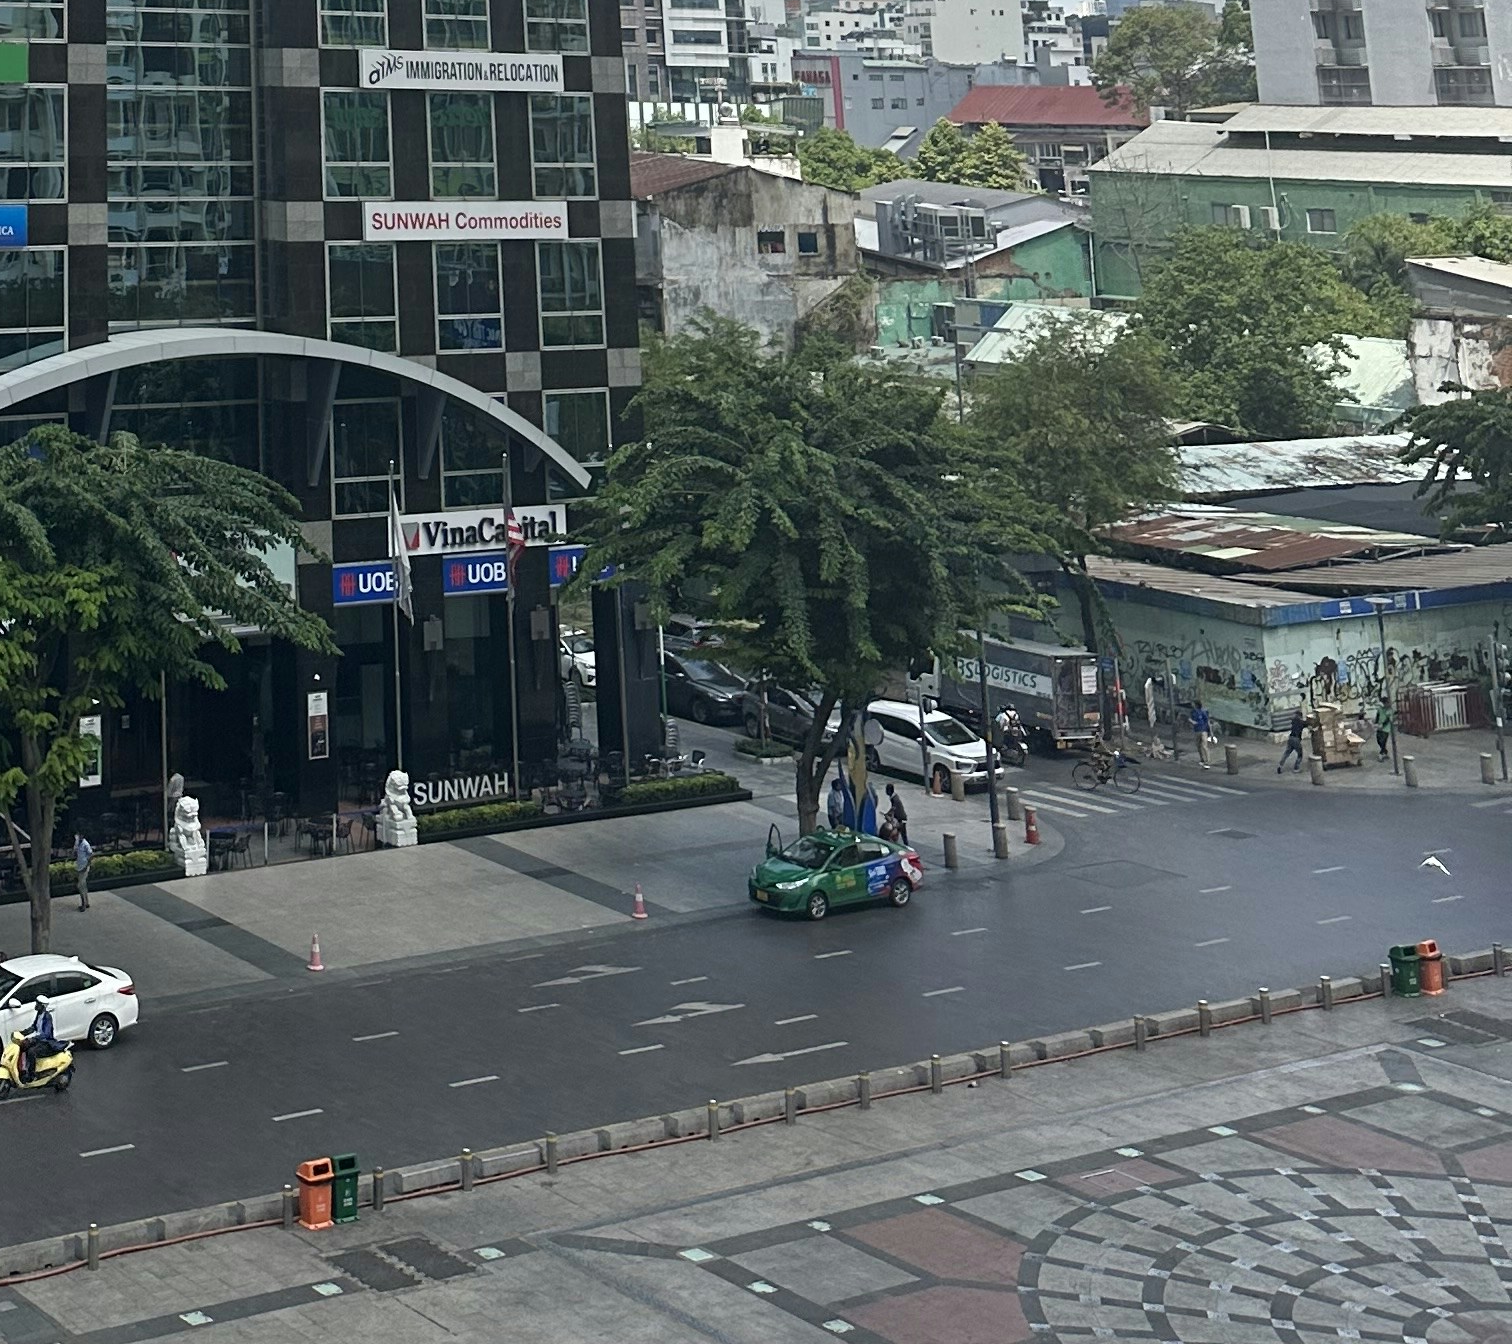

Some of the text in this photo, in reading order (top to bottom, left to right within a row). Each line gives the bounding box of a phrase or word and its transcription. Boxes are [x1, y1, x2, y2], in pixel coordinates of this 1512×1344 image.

[406, 61, 482, 80] IMMIGRATION
[489, 63, 558, 82] RELOCATION
[372, 212, 562, 230] SUNWAH Commodities
[422, 510, 557, 548] VinaCaital
[467, 561, 506, 584] UOB
[413, 772, 508, 806] SUNWAH
